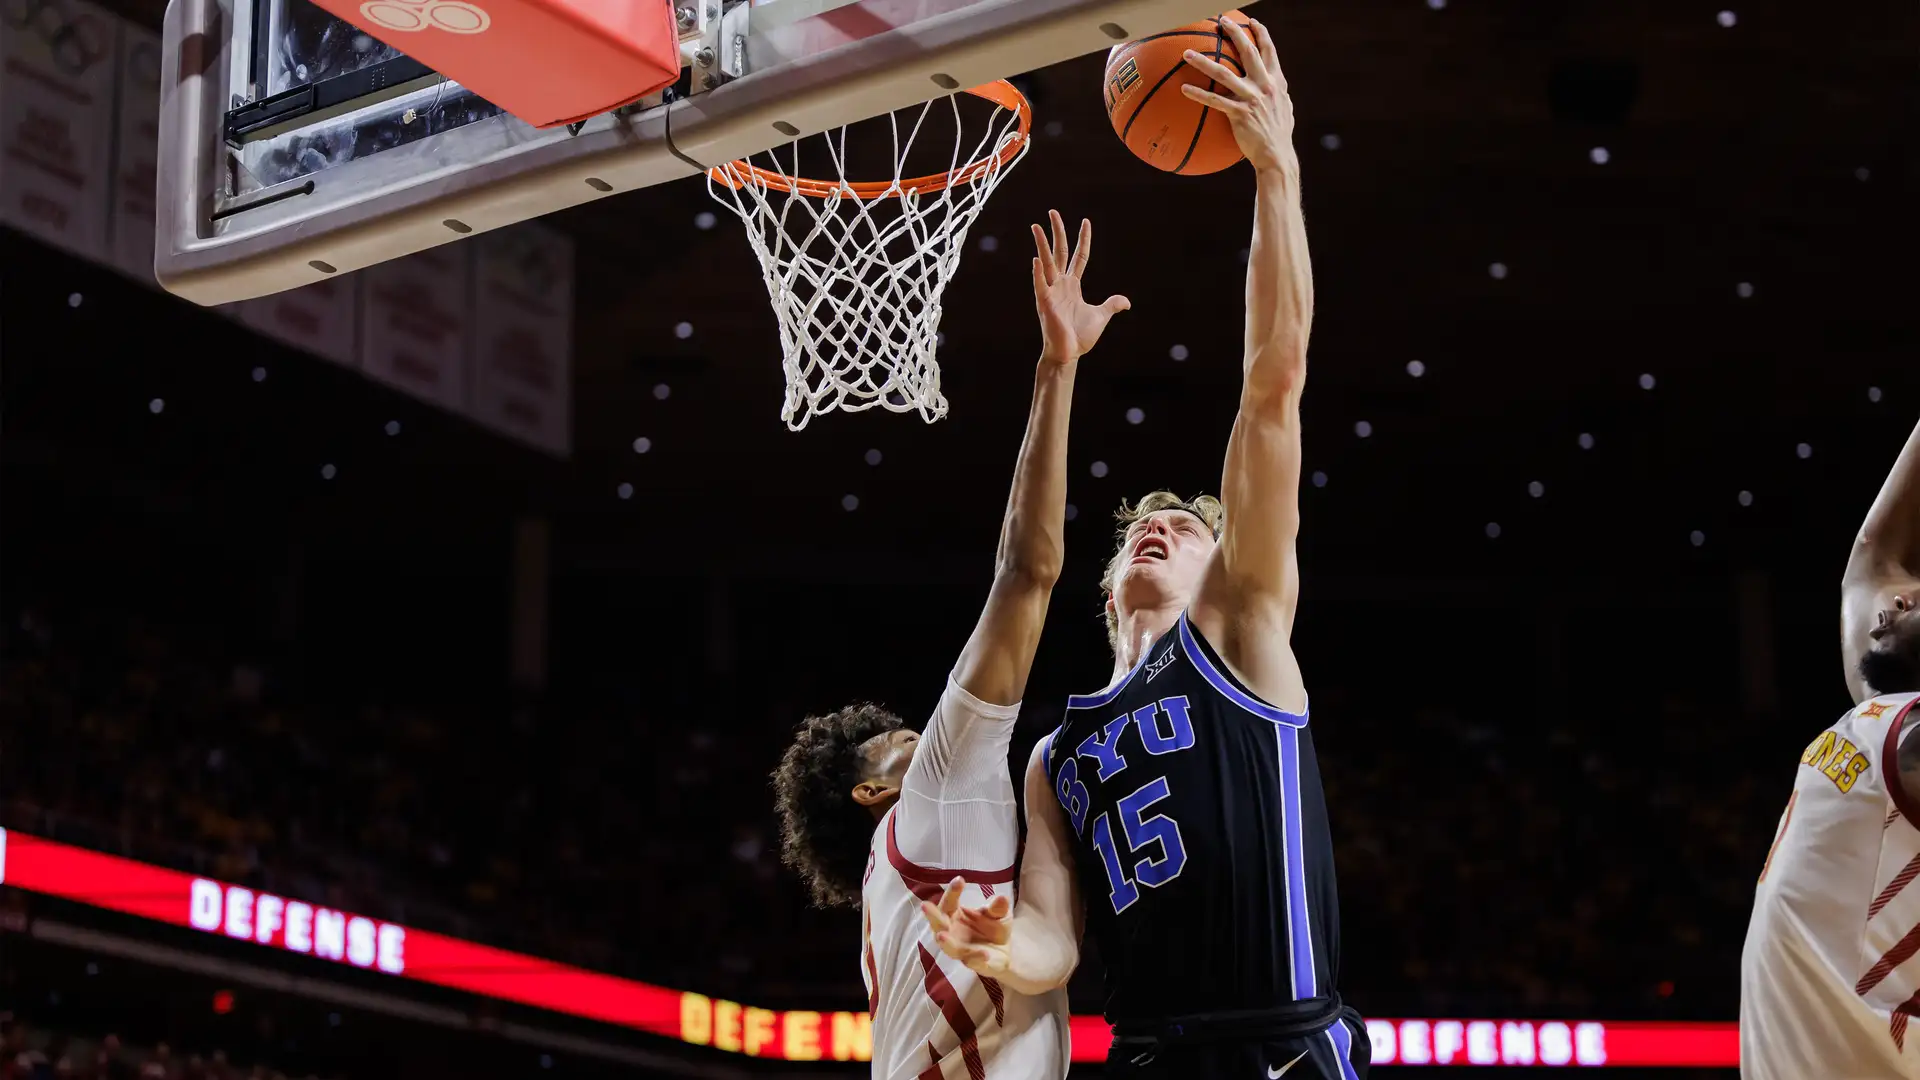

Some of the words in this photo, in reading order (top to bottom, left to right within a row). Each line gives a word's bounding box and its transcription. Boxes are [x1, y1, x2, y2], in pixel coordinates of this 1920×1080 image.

[1057, 695, 1195, 842] BYU
[1800, 731, 1871, 794] ONES
[1093, 776, 1187, 915] 15
[190, 878, 406, 975] DEFENSE
[679, 991, 872, 1062] DEFEN
[1364, 1019, 1607, 1067] DEFENSE
